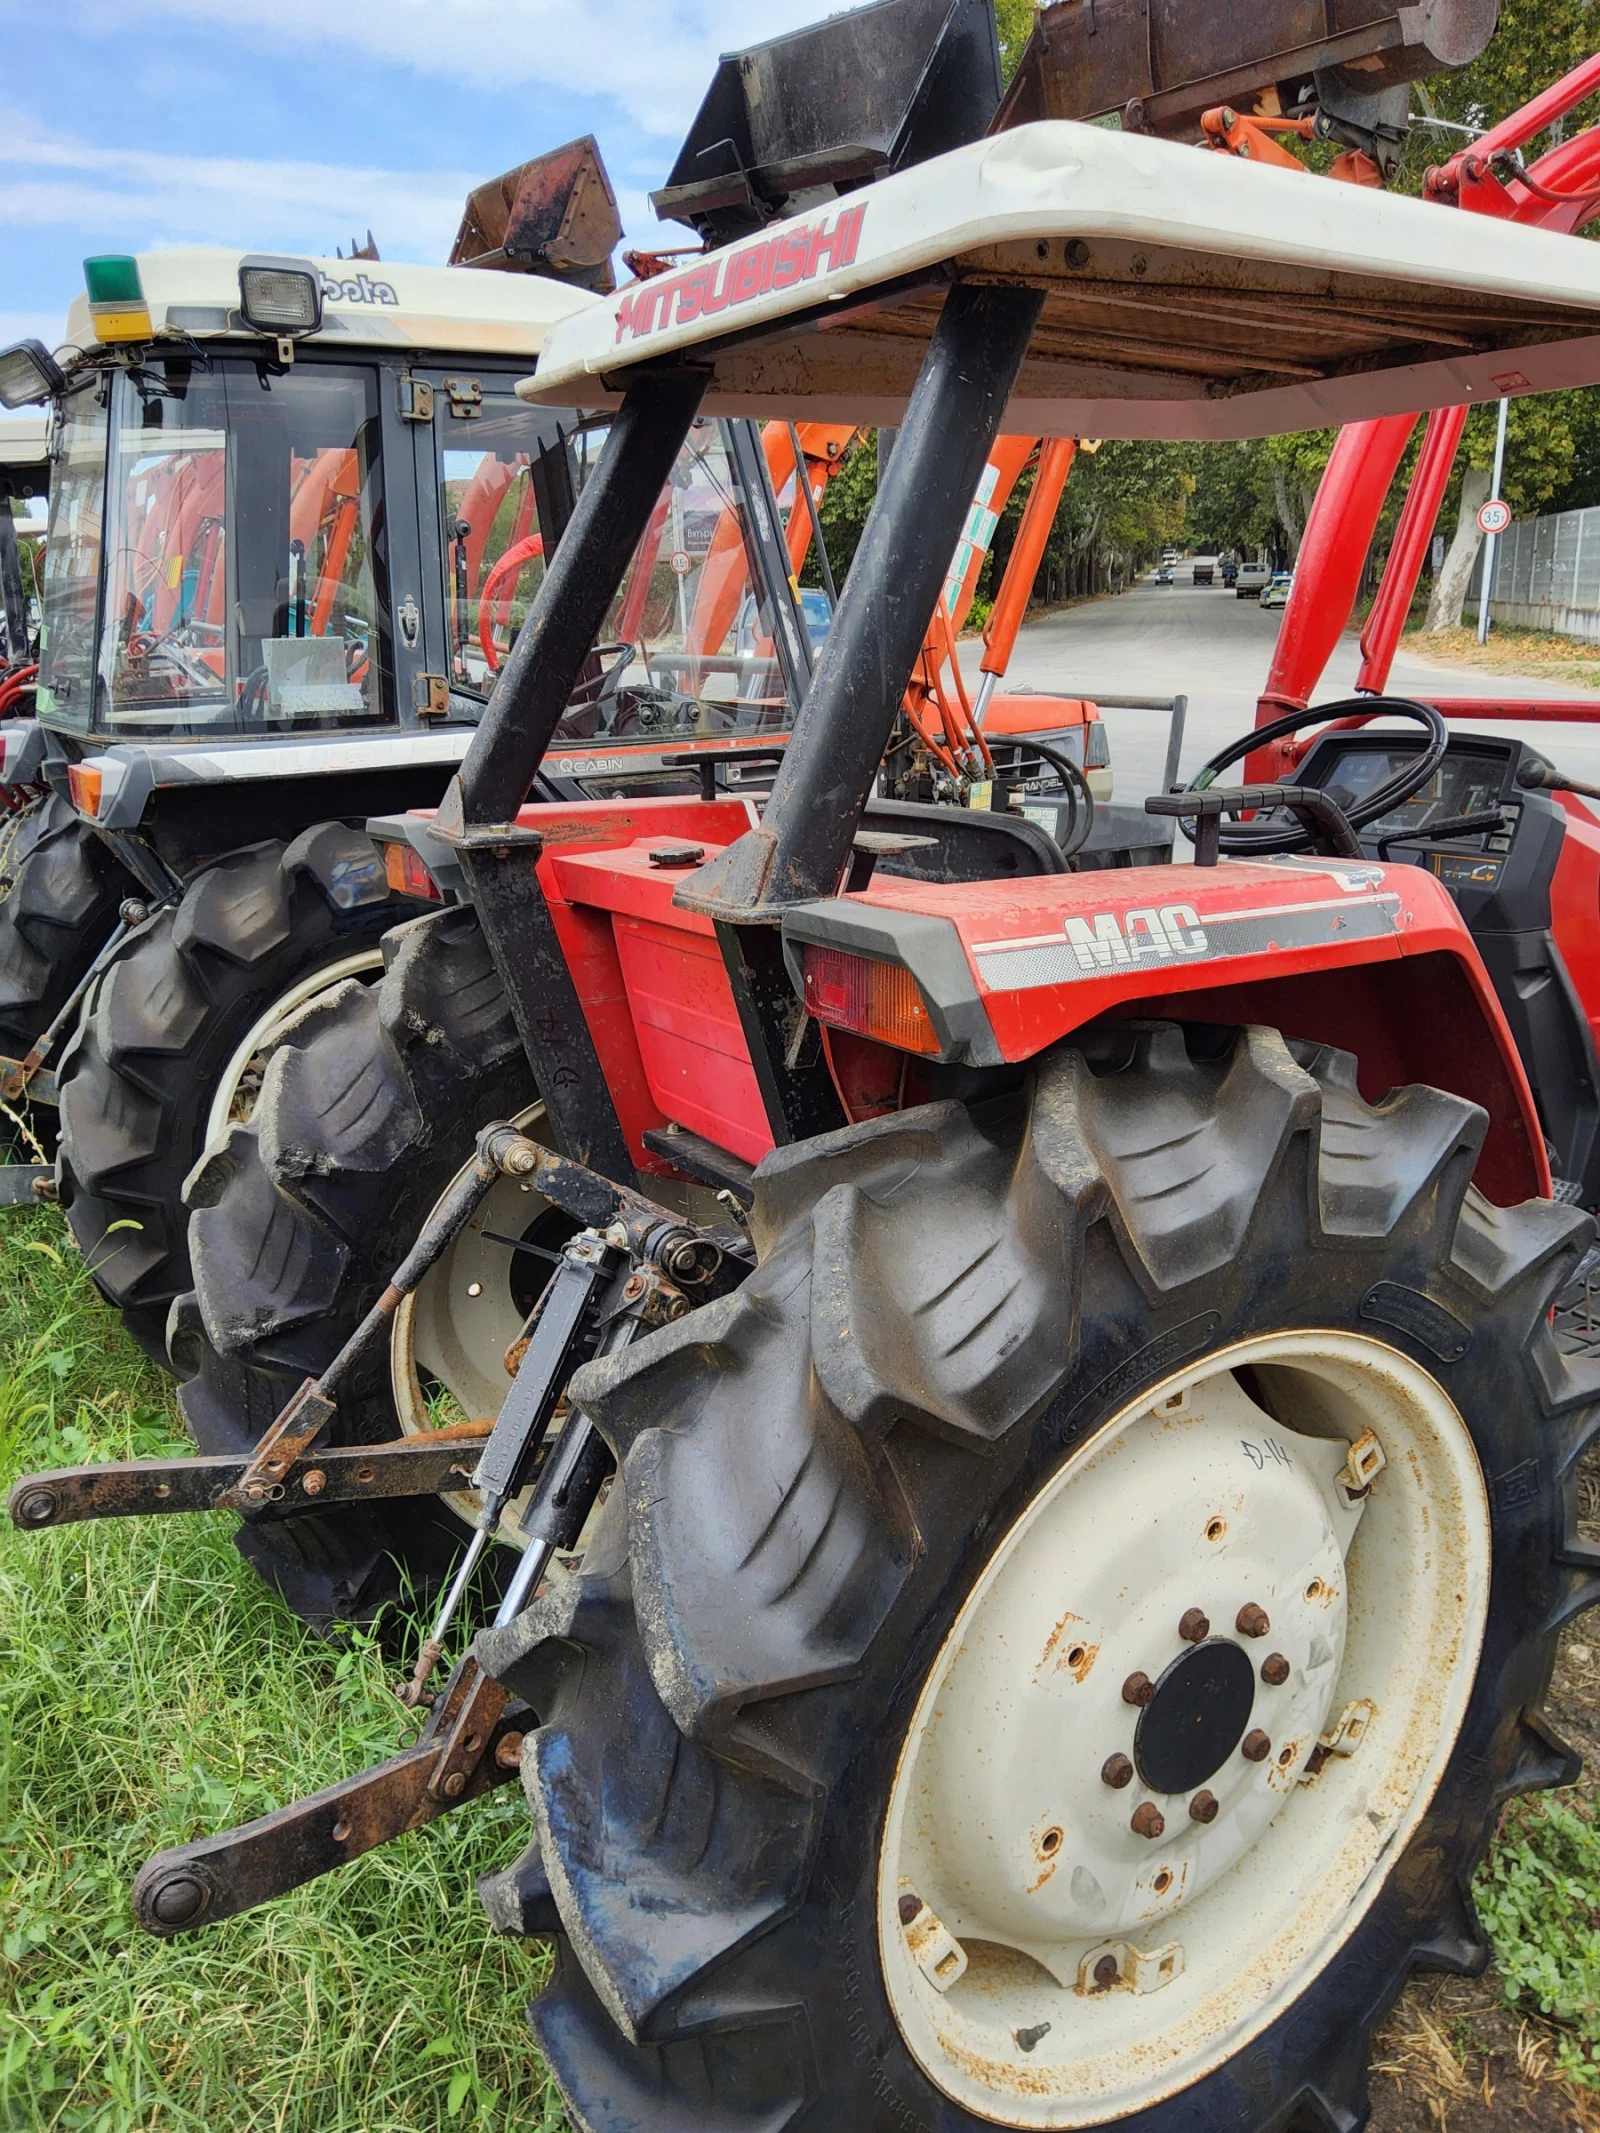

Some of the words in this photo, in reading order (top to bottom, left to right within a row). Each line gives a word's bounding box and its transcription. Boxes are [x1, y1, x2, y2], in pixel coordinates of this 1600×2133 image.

[319, 271, 399, 306] bota
[615, 201, 869, 344] MITSUBISHI
[1064, 904, 1208, 971] MAC
